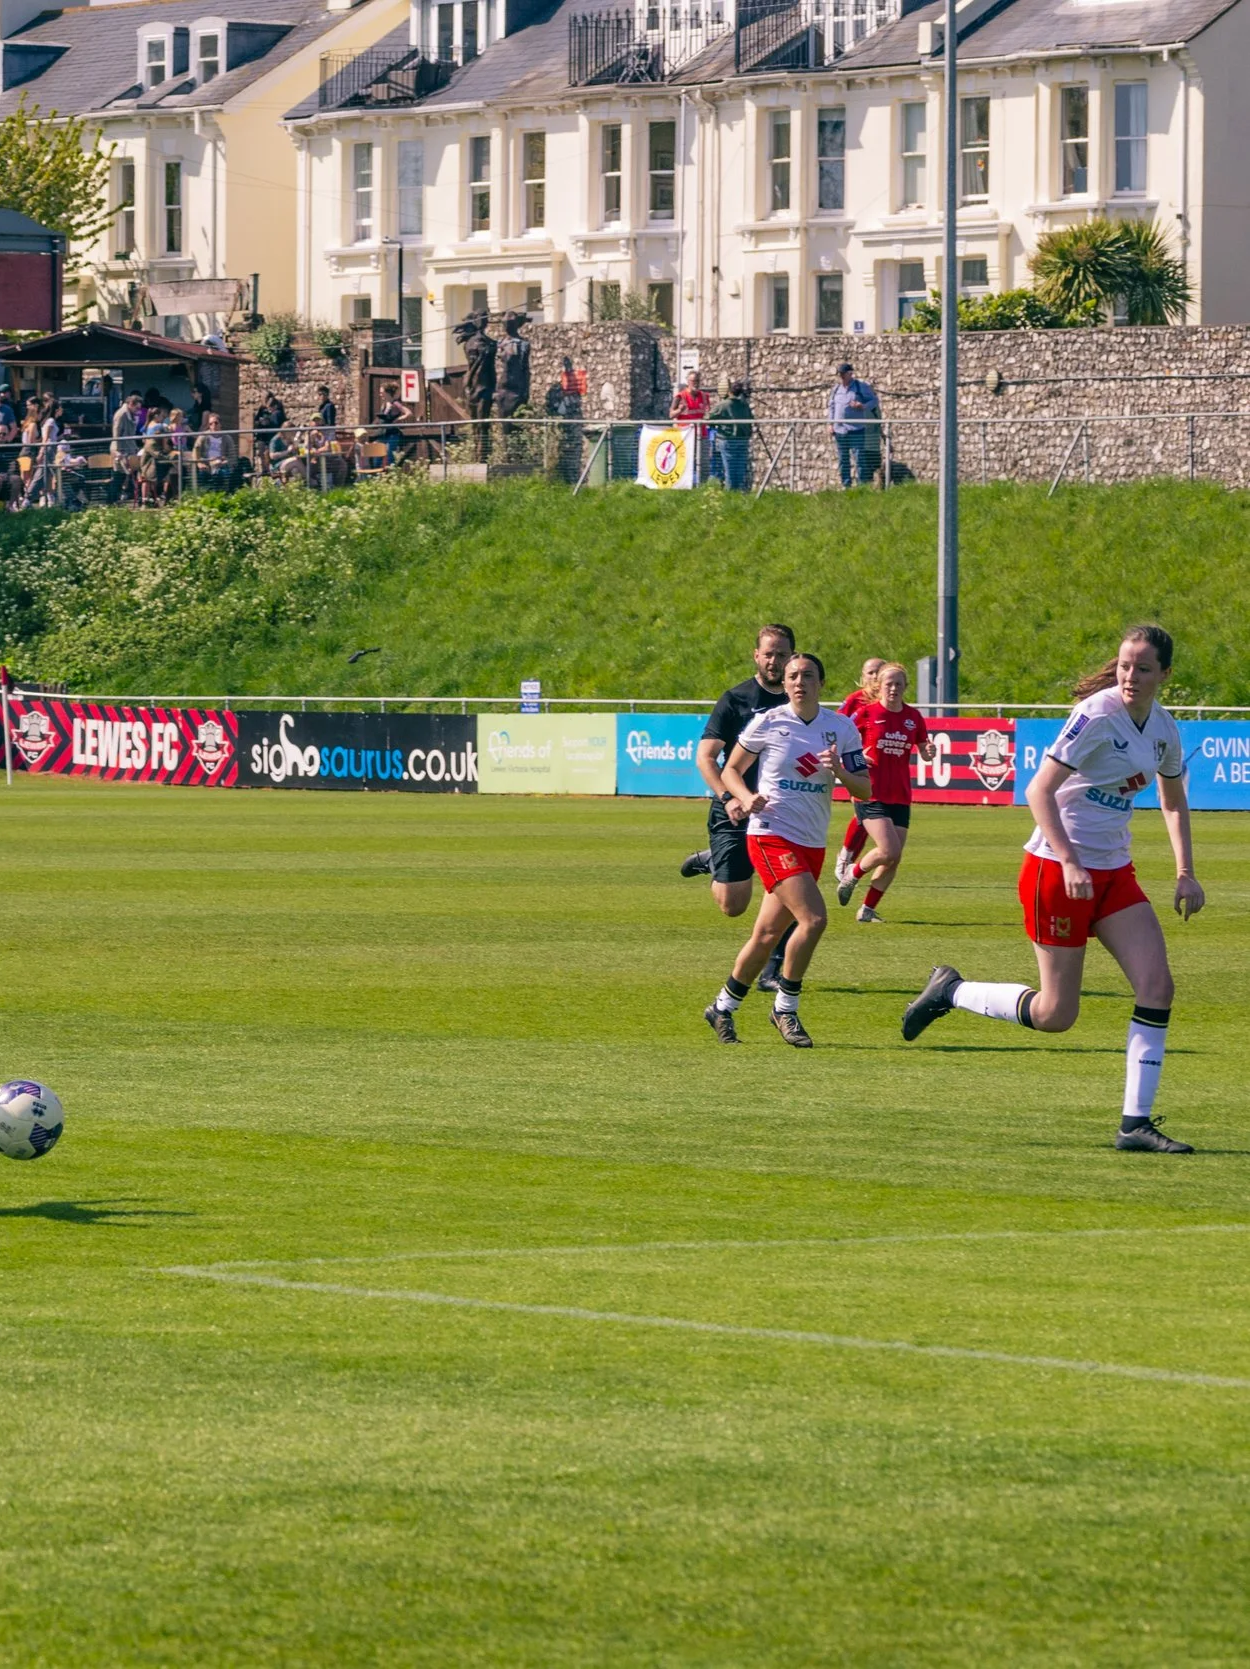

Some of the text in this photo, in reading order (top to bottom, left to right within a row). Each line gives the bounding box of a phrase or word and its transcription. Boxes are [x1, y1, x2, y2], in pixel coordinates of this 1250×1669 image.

[405, 373, 416, 398] F
[72, 718, 179, 771] LEWES FC
[885, 730, 908, 742] who
[251, 714, 479, 782] signosaurus.co.uk
[538, 740, 553, 758] of
[626, 731, 694, 766] friends of
[883, 748, 905, 757] crap
[977, 762, 1008, 776] LEWES
[1213, 762, 1227, 783] A
[779, 779, 828, 793] SUZUK
[986, 776, 999, 785] FC
